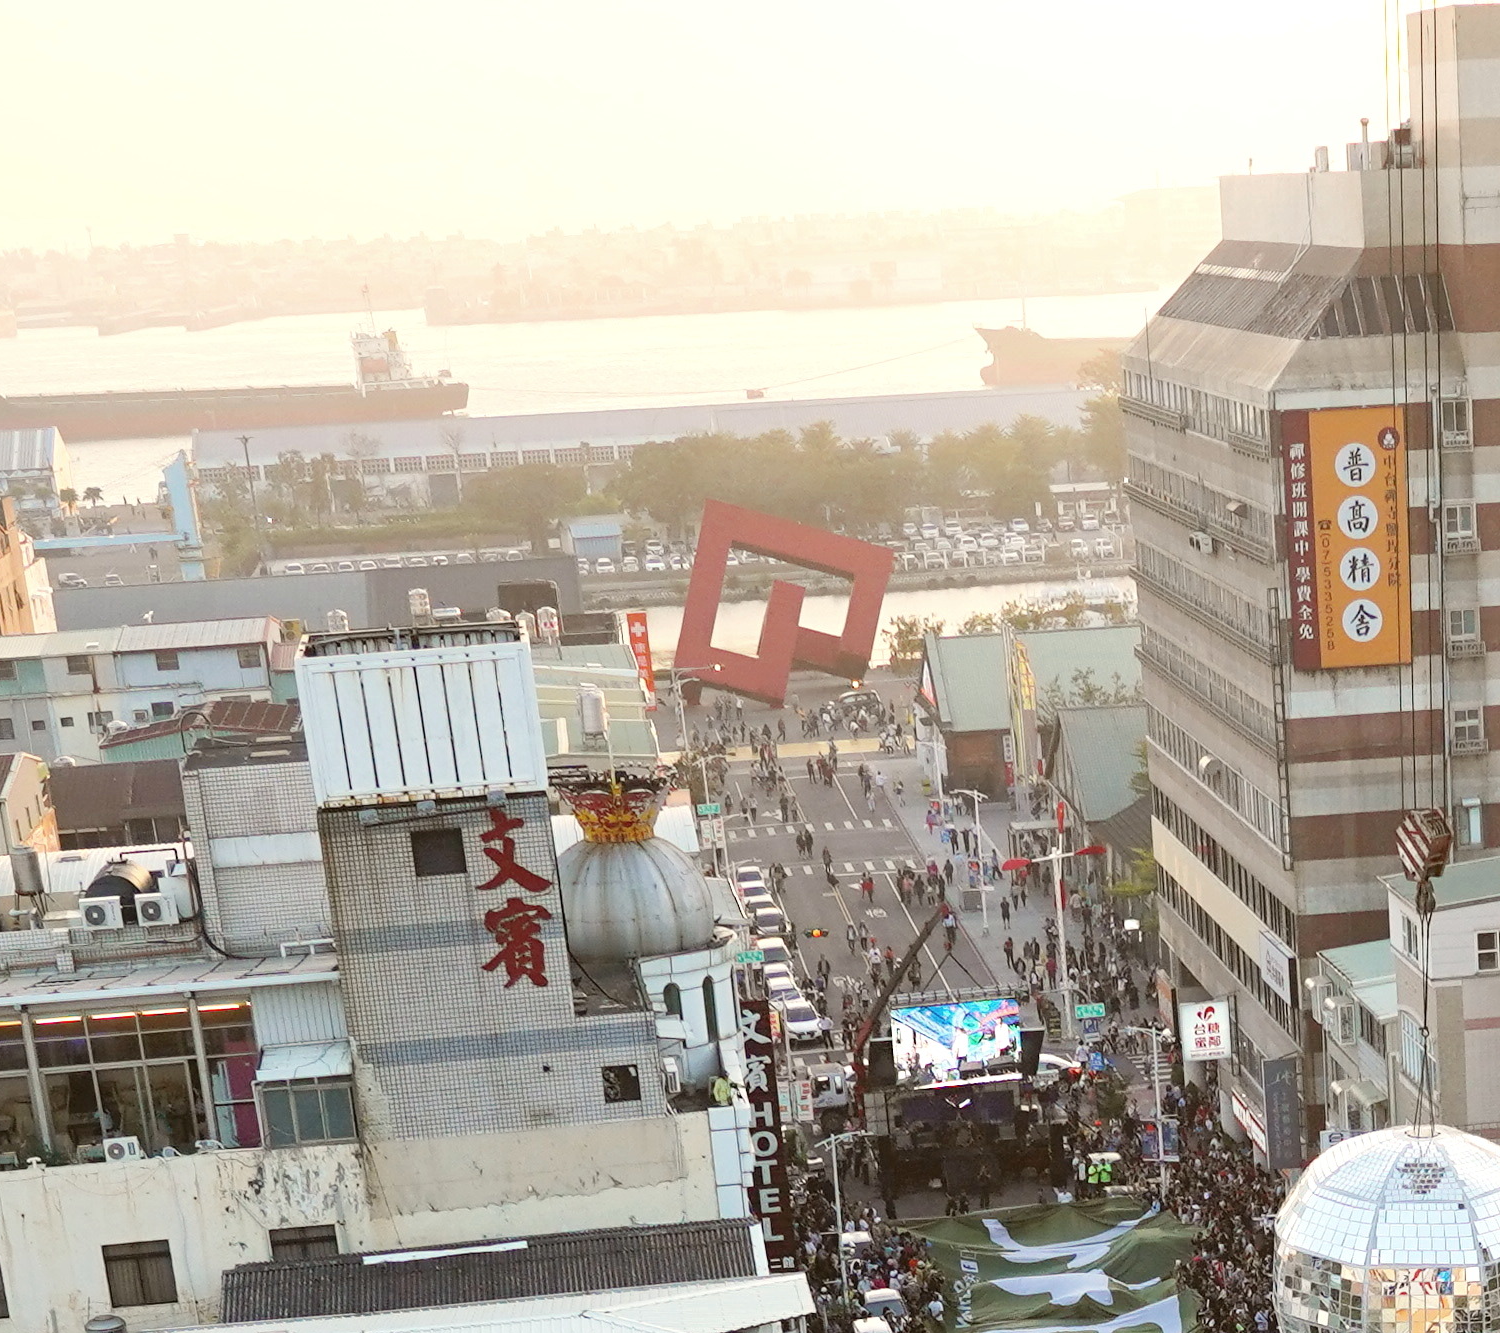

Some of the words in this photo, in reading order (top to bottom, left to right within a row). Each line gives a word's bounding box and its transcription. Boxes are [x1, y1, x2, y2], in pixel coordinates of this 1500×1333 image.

[1343, 448, 1379, 637] 普高精舍
[476, 808, 552, 988] 文賓
[741, 1008, 772, 1094] 文賓
[750, 1101, 784, 1242] HOTEL
